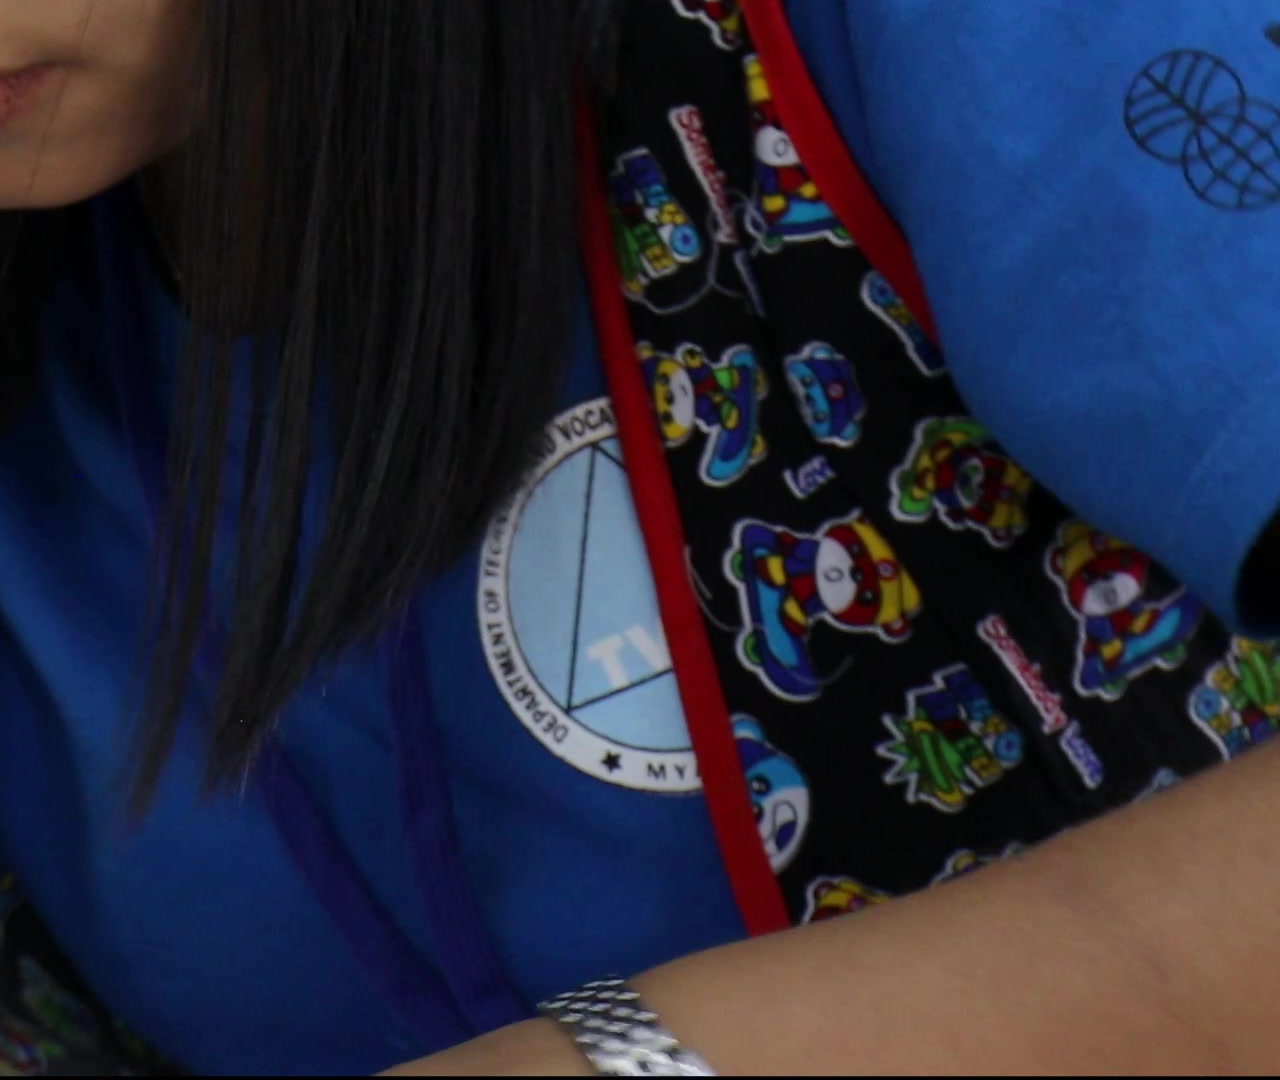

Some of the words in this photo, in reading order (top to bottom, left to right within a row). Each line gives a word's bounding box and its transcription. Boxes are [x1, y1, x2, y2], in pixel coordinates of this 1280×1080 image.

[555, 406, 614, 441] VOCA
[484, 516, 508, 577] TECH
[484, 589, 500, 614] OF
[586, 620, 673, 689] TV
[487, 622, 569, 744] DEPARTMENT
[647, 762, 703, 782] MY
